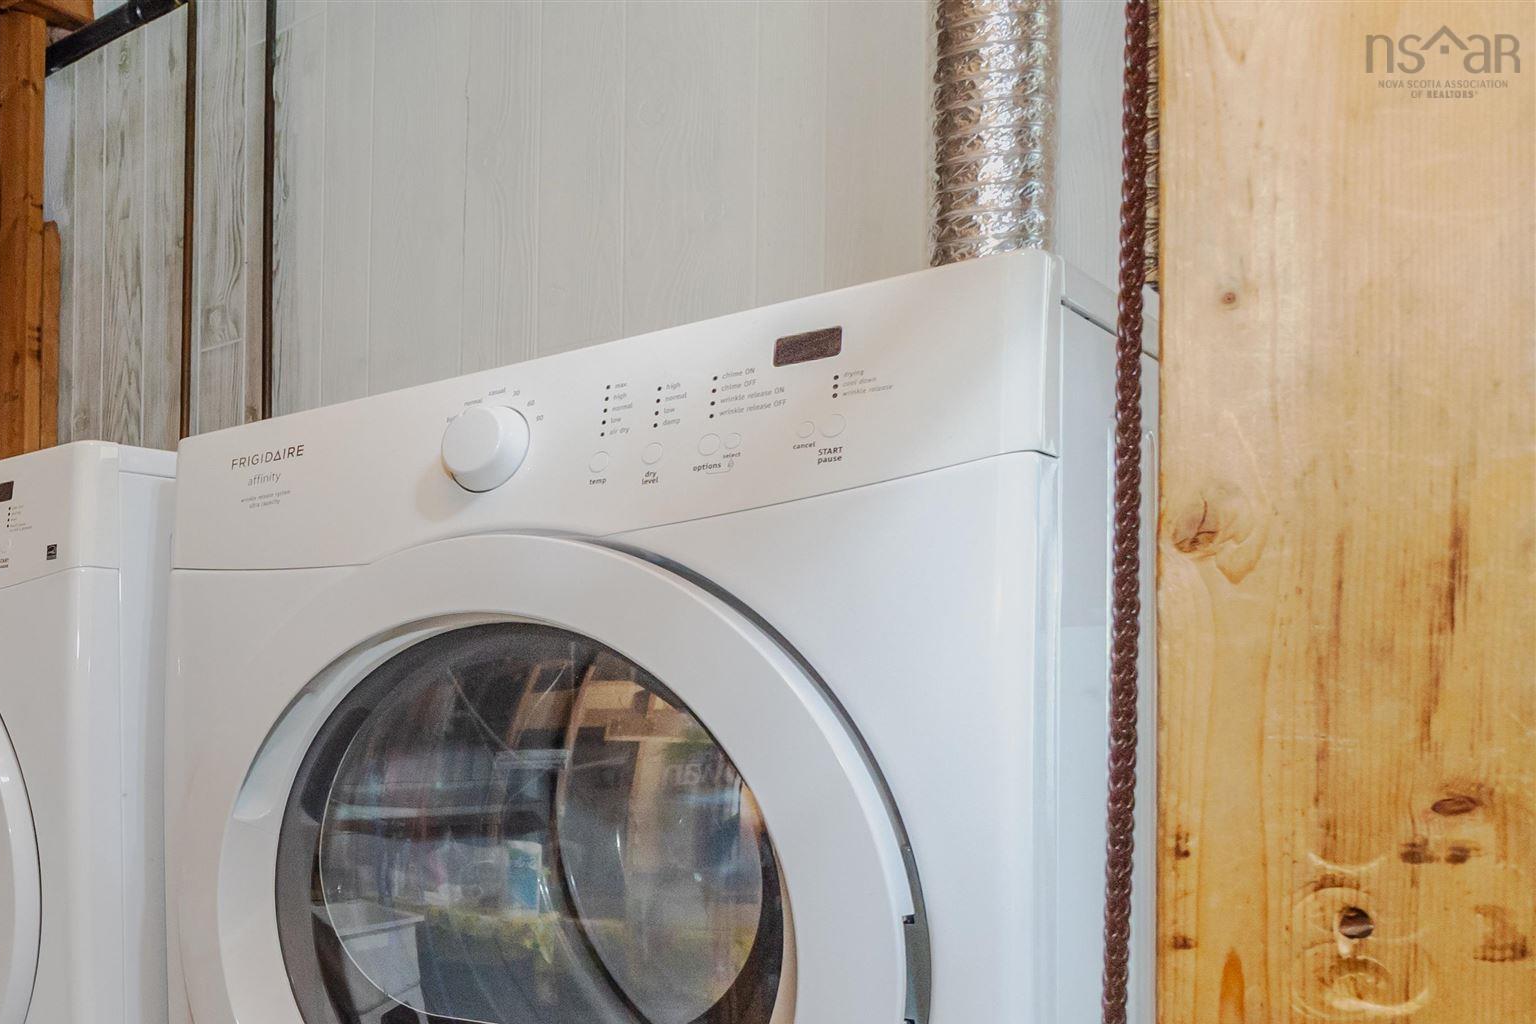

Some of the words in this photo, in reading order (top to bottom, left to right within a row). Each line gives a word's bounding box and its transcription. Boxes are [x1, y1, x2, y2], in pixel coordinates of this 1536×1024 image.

[744, 379, 757, 387] OFF
[720, 394, 745, 403] wrinkle
[747, 390, 772, 399] release
[774, 386, 785, 394] ON
[746, 402, 772, 412] release
[773, 398, 786, 407] OFF
[793, 441, 816, 449] cancel
[722, 451, 741, 459] select
[818, 446, 843, 456] START
[231, 445, 305, 470] FRIGIDAIRE
[817, 455, 842, 465] pause
[692, 462, 722, 472] options
[248, 473, 282, 486] affinity
[645, 470, 657, 479] dry
[589, 477, 607, 486] temp
[641, 477, 659, 485] level
